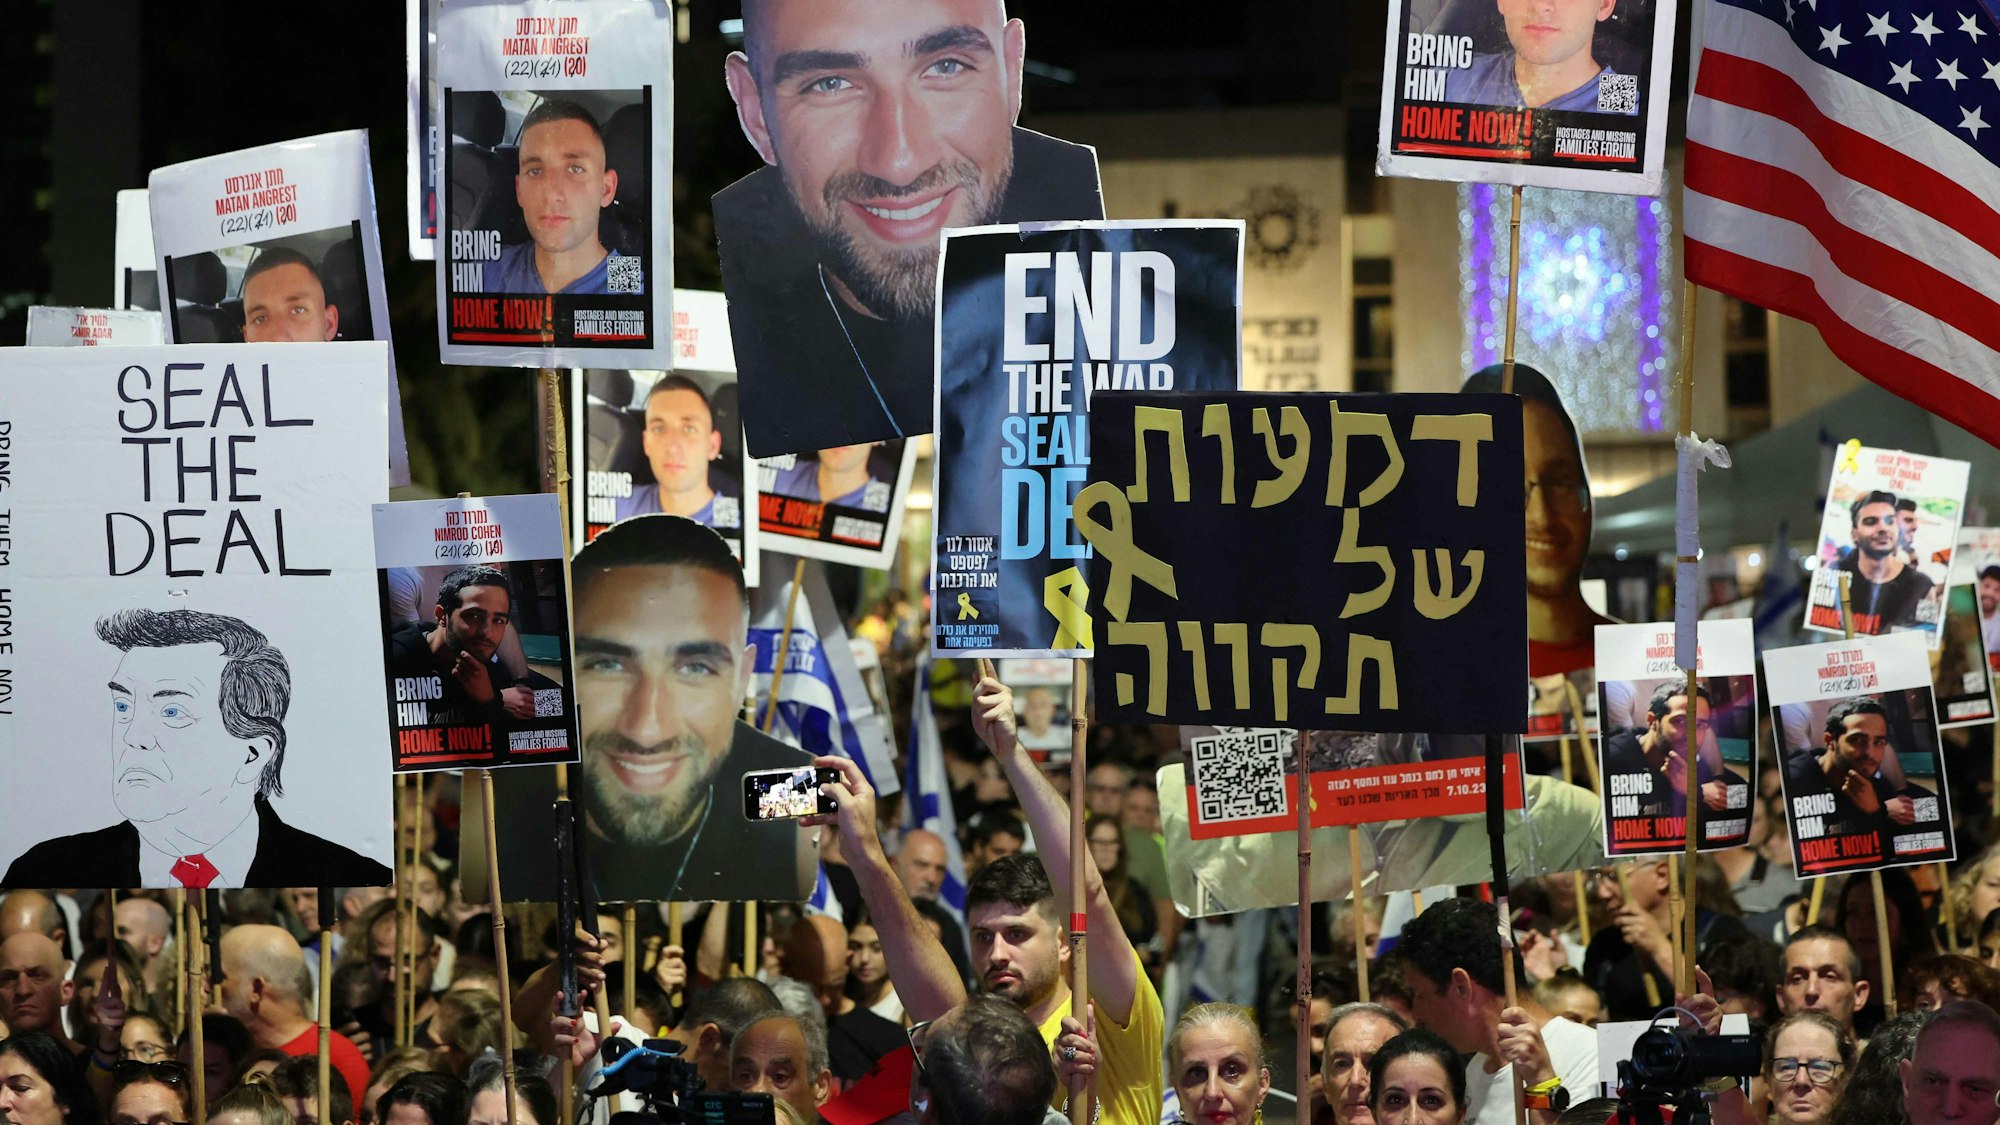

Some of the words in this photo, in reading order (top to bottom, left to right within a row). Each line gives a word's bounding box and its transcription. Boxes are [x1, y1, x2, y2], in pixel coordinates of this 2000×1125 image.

[559, 17, 578, 36] מתן
[502, 38, 538, 56] MATAN
[541, 37, 590, 55] ANGREST
[1406, 32, 1474, 69] BRING
[1403, 67, 1447, 102] HIM
[1401, 105, 1464, 141] HOME
[1468, 109, 1533, 147] NOW!
[1556, 126, 1591, 140] HOSTAGES
[1591, 129, 1605, 141] AND
[1606, 130, 1636, 143] MISSING
[1554, 138, 1599, 156] FAMILIES
[1600, 141, 1635, 159] FORUM
[264, 168, 284, 188] מתן
[216, 194, 250, 216] MATAN
[252, 184, 297, 209] ANGREST
[451, 229, 501, 261] BRING
[452, 262, 484, 293] HIM
[453, 297, 500, 329] HOME
[503, 295, 554, 330] NOW!
[574, 309, 604, 321] HOSTAGES
[605, 310, 617, 321] AND
[618, 310, 645, 321] MISSING
[1003, 250, 1176, 361] END
[71, 326, 91, 339] TAMIR
[92, 328, 112, 339] ADAR
[574, 320, 613, 335] FAMILIES
[614, 320, 645, 336] FORUM
[117, 363, 314, 433] SEAL
[1002, 363, 1073, 413] THE
[1001, 415, 1091, 466] SEAL
[1126, 399, 1494, 508] דמעות
[121, 434, 262, 503] THE
[587, 470, 633, 498] BRING
[462, 510, 488, 524] נמרוד
[587, 497, 617, 523] HIM
[783, 499, 825, 530] NOW!
[1001, 467, 1094, 560] DE
[106, 508, 332, 577] DEAL
[434, 527, 468, 542] NIMROD
[471, 524, 502, 540] COHEN
[946, 536, 963, 552] לנו
[966, 536, 993, 552] אסור
[950, 554, 989, 570] לפספס
[1333, 507, 1485, 620] של
[940, 572, 978, 588] הרכבת
[980, 572, 998, 588] את
[955, 624, 967, 635] את
[968, 624, 999, 635] מחזירים
[1852, 611, 1881, 635] OW!
[945, 636, 962, 648] אחת
[963, 636, 992, 647] בפעימה
[1106, 621, 1399, 722] תקווה
[1818, 664, 1848, 680] NIMROD
[1849, 661, 1876, 676] COHEN
[394, 676, 442, 702] BRING
[396, 702, 428, 727] HIM
[398, 728, 444, 754] HOME
[447, 724, 492, 750] NOW!
[508, 730, 534, 740] HOSTAGES
[534, 730, 544, 738] AND
[545, 728, 567, 738] MISSING
[510, 738, 542, 751] FAMILIES
[542, 736, 568, 750] FORUM
[1446, 782, 1486, 796] 7.10.23
[1610, 772, 1653, 796] BRING
[1612, 795, 1639, 818] HIM
[1792, 792, 1836, 818] BRING
[1614, 818, 1652, 840] HOME
[1796, 816, 1824, 840] HIM
[1800, 837, 1840, 863] HOME
[1841, 831, 1881, 857] NOW!
